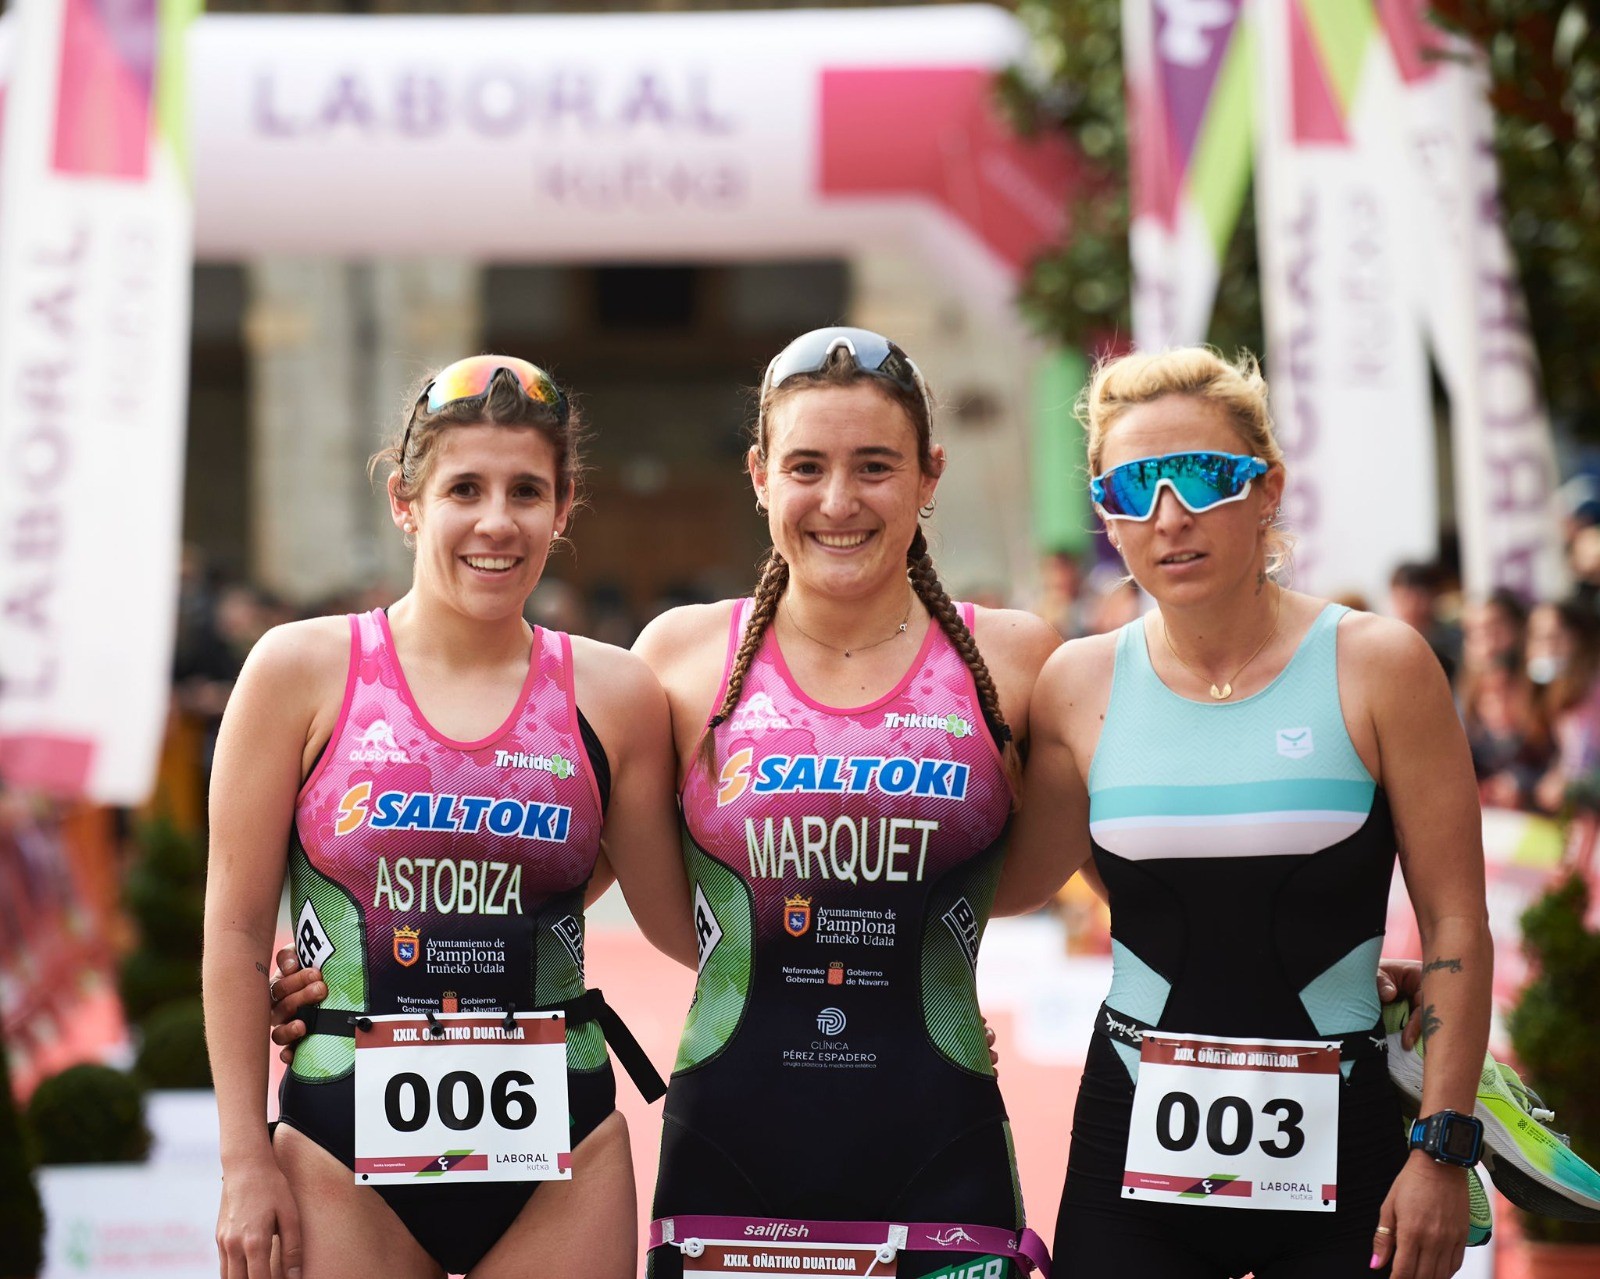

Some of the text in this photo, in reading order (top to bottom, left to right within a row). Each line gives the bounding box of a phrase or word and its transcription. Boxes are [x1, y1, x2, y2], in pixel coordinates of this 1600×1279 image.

[753, 755, 970, 801] SALTOKI
[369, 790, 572, 843] SALTOKI
[744, 816, 939, 885] MARQUET
[373, 856, 523, 915] ASTOBIZA
[817, 906, 897, 920] Ayuntamiento de
[817, 918, 896, 935] Pamplona
[426, 938, 505, 949] Ayuntamiento de
[816, 933, 895, 946] Iruñeko Udala
[426, 948, 505, 966] Pamplona
[427, 962, 505, 973] Iruñeko Udala
[782, 966, 825, 975] Nafarroako
[847, 968, 883, 977] Gobierno
[786, 975, 825, 984] Gobernua
[858, 978, 889, 986] Navarra
[397, 996, 439, 1005] Nafarroako
[461, 997, 496, 1005] Gobierno
[393, 1028, 420, 1041] XXIX.
[810, 1041, 849, 1050] CLÍNICA
[783, 1050, 877, 1061] PÉREZ ESPADERO
[384, 1070, 537, 1132] 006
[1156, 1091, 1305, 1158] 003
[496, 1153, 549, 1163] LABORAL
[527, 1163, 550, 1171] kutxa
[1260, 1182, 1313, 1193] LABORAL
[744, 1223, 809, 1240] sailfish
[723, 1253, 857, 1270] XXIX. OÑATIKO DUATLOIA
